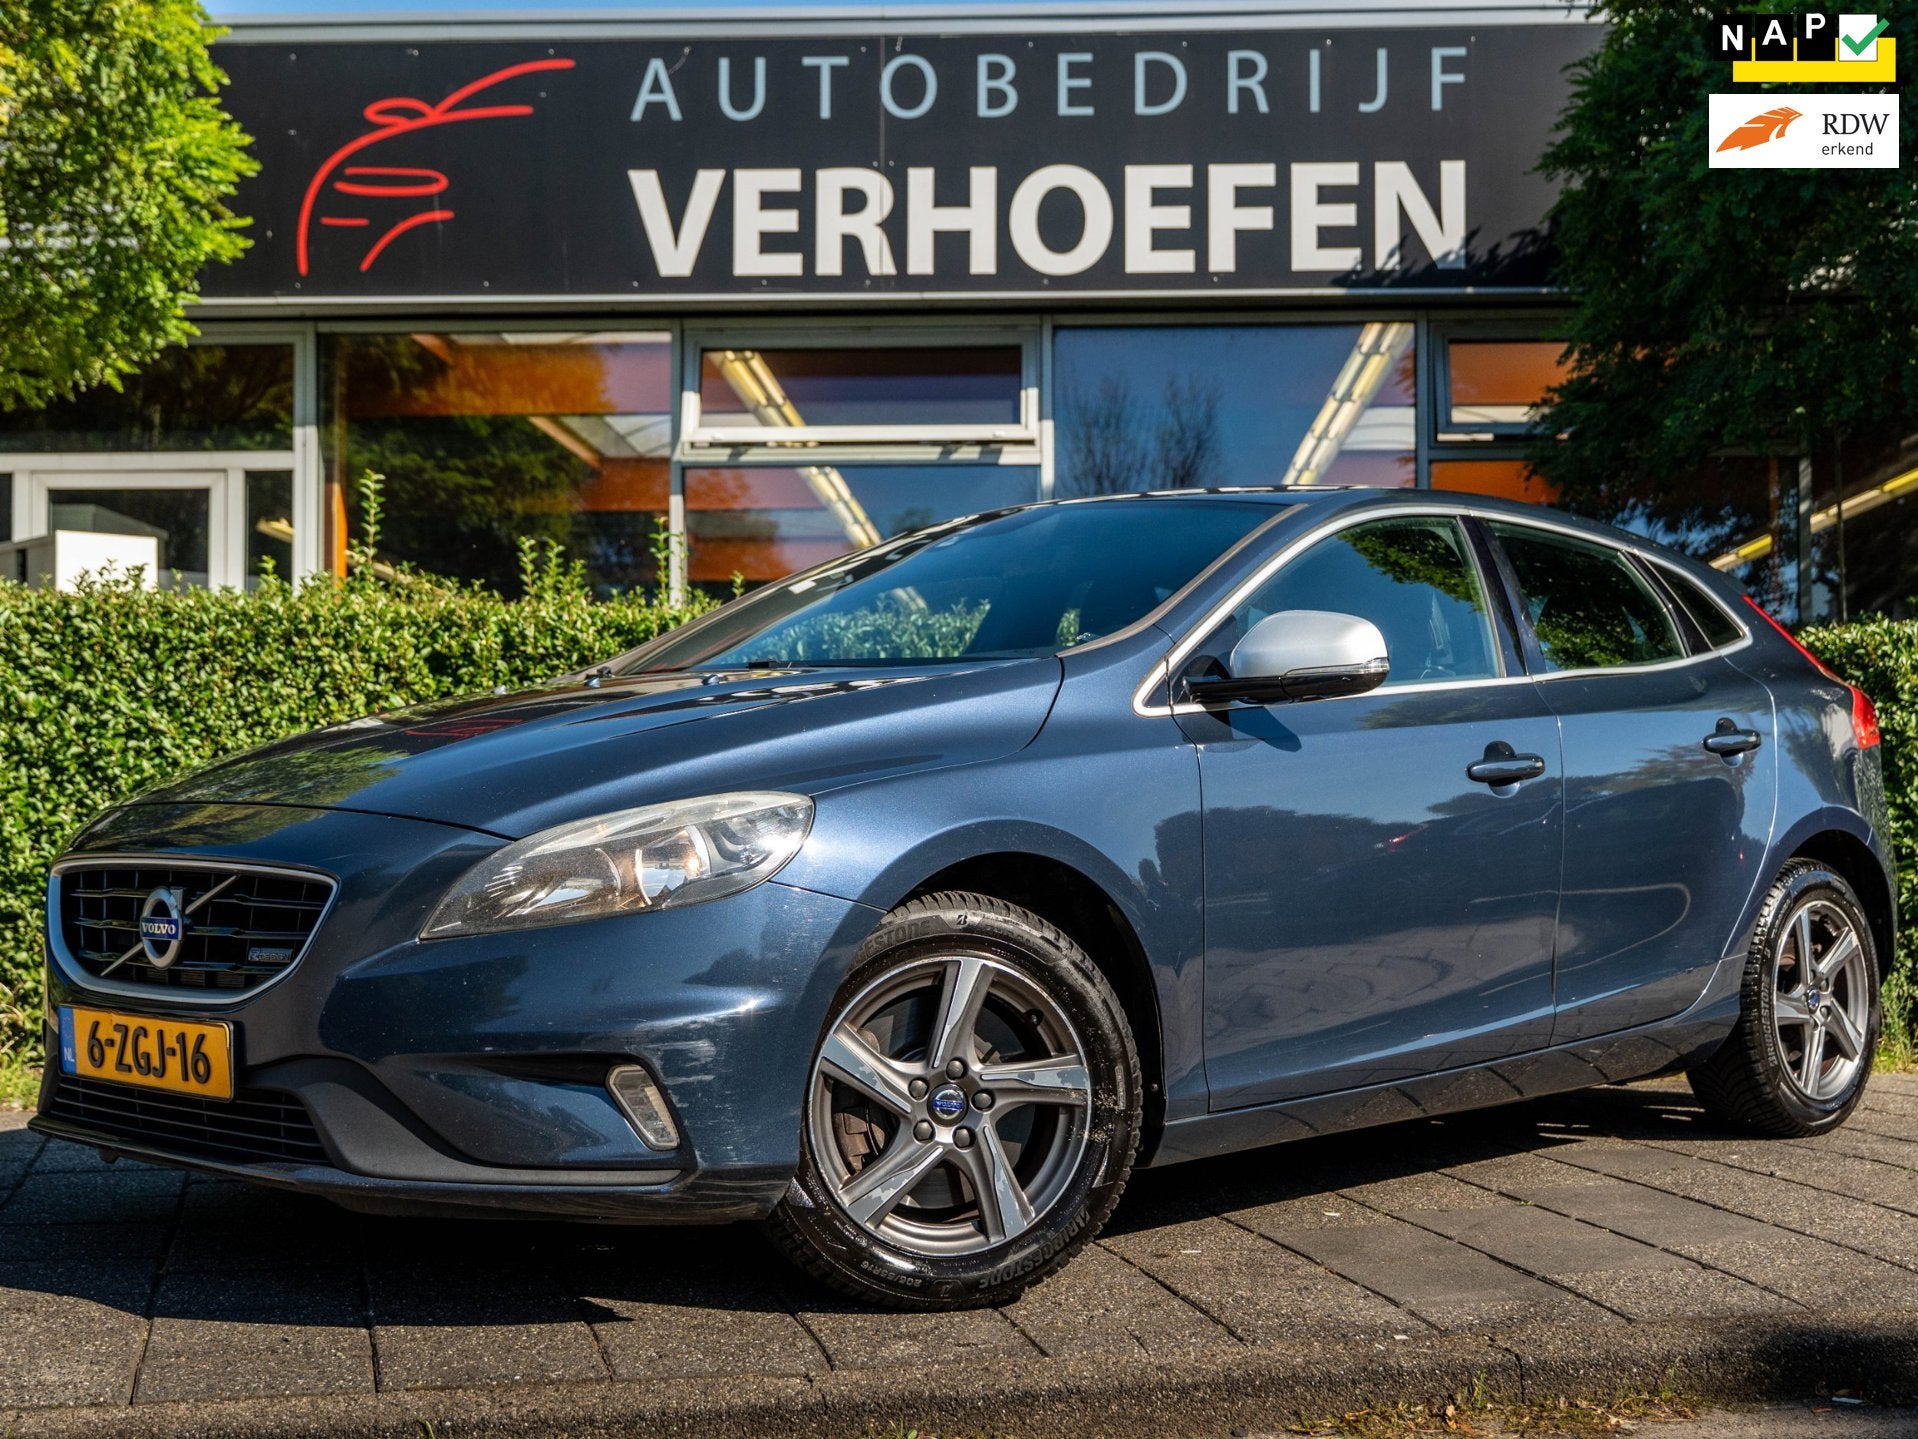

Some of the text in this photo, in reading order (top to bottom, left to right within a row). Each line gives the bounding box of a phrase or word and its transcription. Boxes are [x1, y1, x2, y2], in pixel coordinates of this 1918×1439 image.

[629, 46, 1469, 122] AUTOBEDRIJF
[627, 159, 1468, 279] VERHOEFEN
[141, 921, 177, 936] VOLVO
[63, 1046, 75, 1063] NL
[86, 1019, 211, 1085] 6-ZGJ-16
